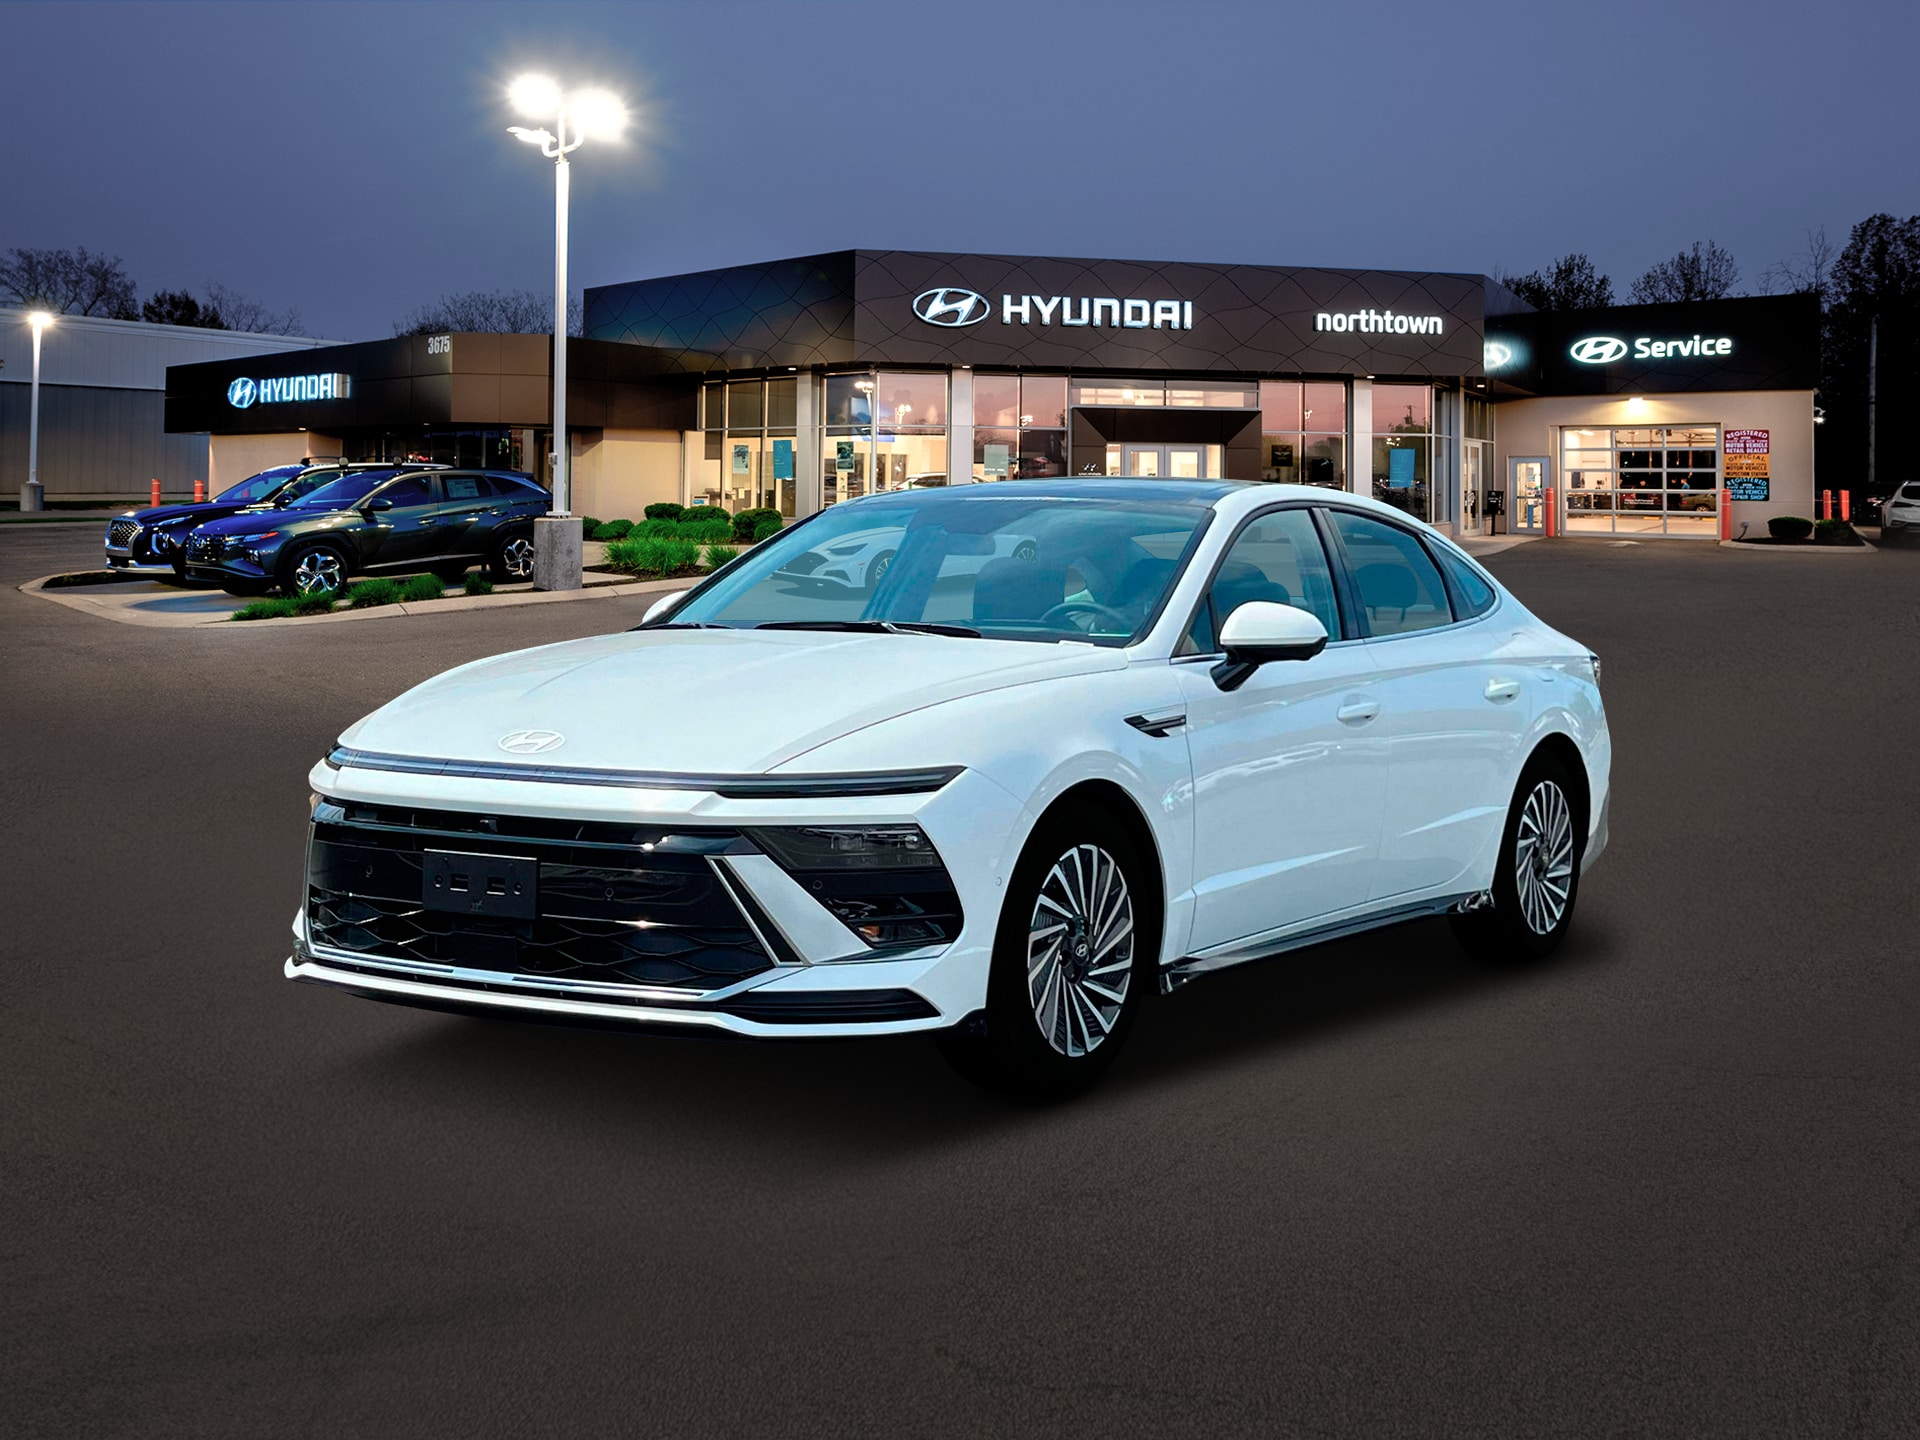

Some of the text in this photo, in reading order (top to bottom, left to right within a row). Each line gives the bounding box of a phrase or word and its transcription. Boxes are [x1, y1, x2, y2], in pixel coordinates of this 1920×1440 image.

[1002, 294, 1193, 330] HYUNDAI
[1316, 309, 1443, 335] northtown
[427, 335, 450, 355] 3675
[1634, 335, 1733, 358] Service
[259, 373, 345, 403] HYUNDAI
[1726, 430, 1768, 439] REGISTERED
[1728, 454, 1766, 462] OFFICIAL
[1726, 477, 1767, 486] REGISTERED
